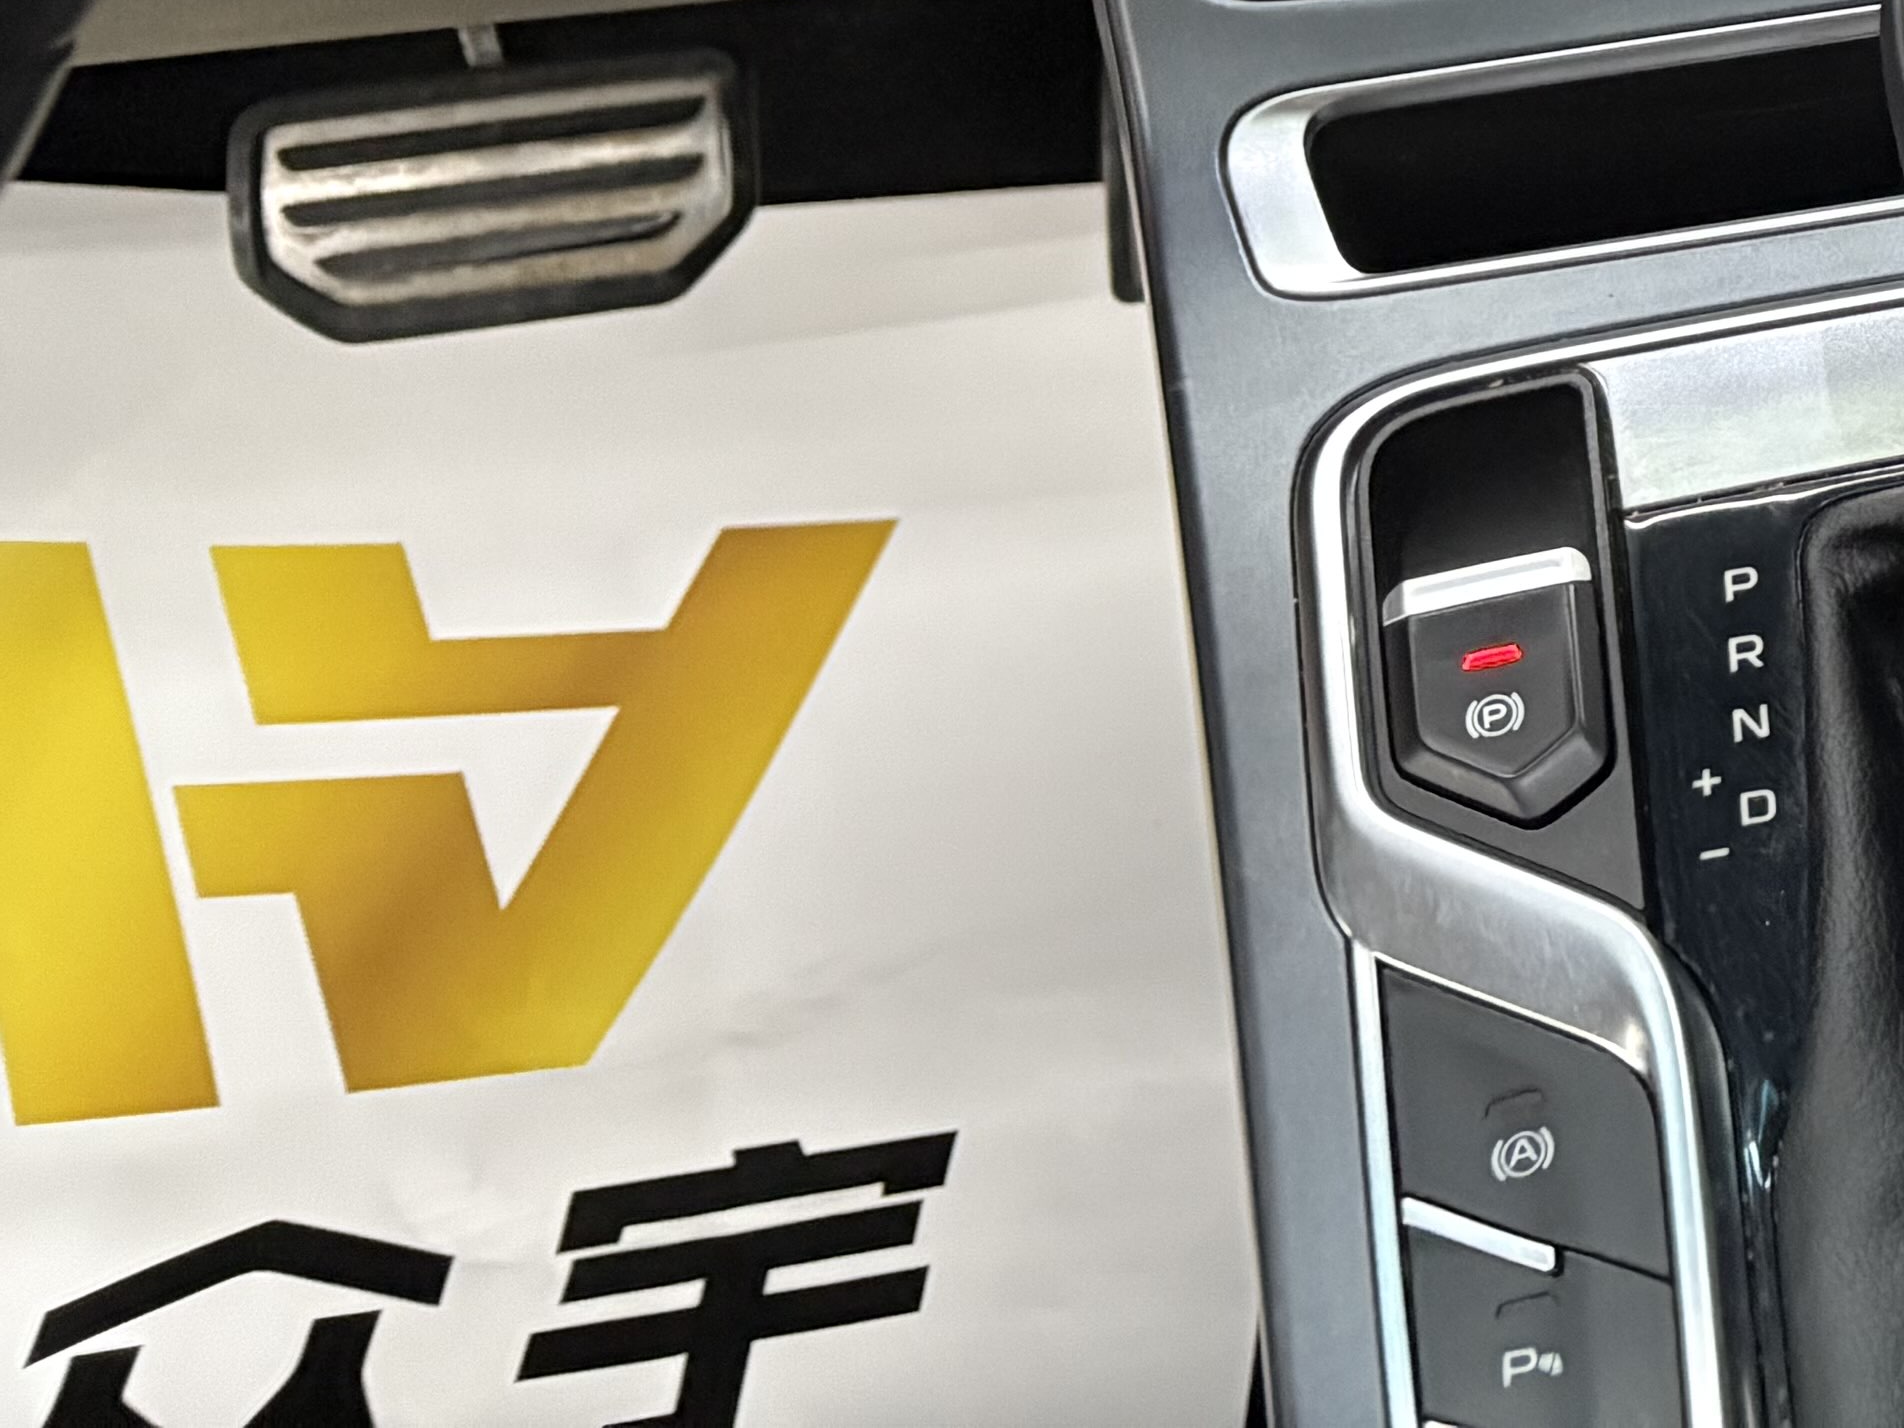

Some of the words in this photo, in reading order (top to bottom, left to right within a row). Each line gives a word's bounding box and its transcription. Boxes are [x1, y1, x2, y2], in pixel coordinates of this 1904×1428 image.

[1723, 566, 1759, 603] P
[1727, 634, 1764, 673] R
[1732, 703, 1770, 743] N
[1739, 789, 1777, 827] D
